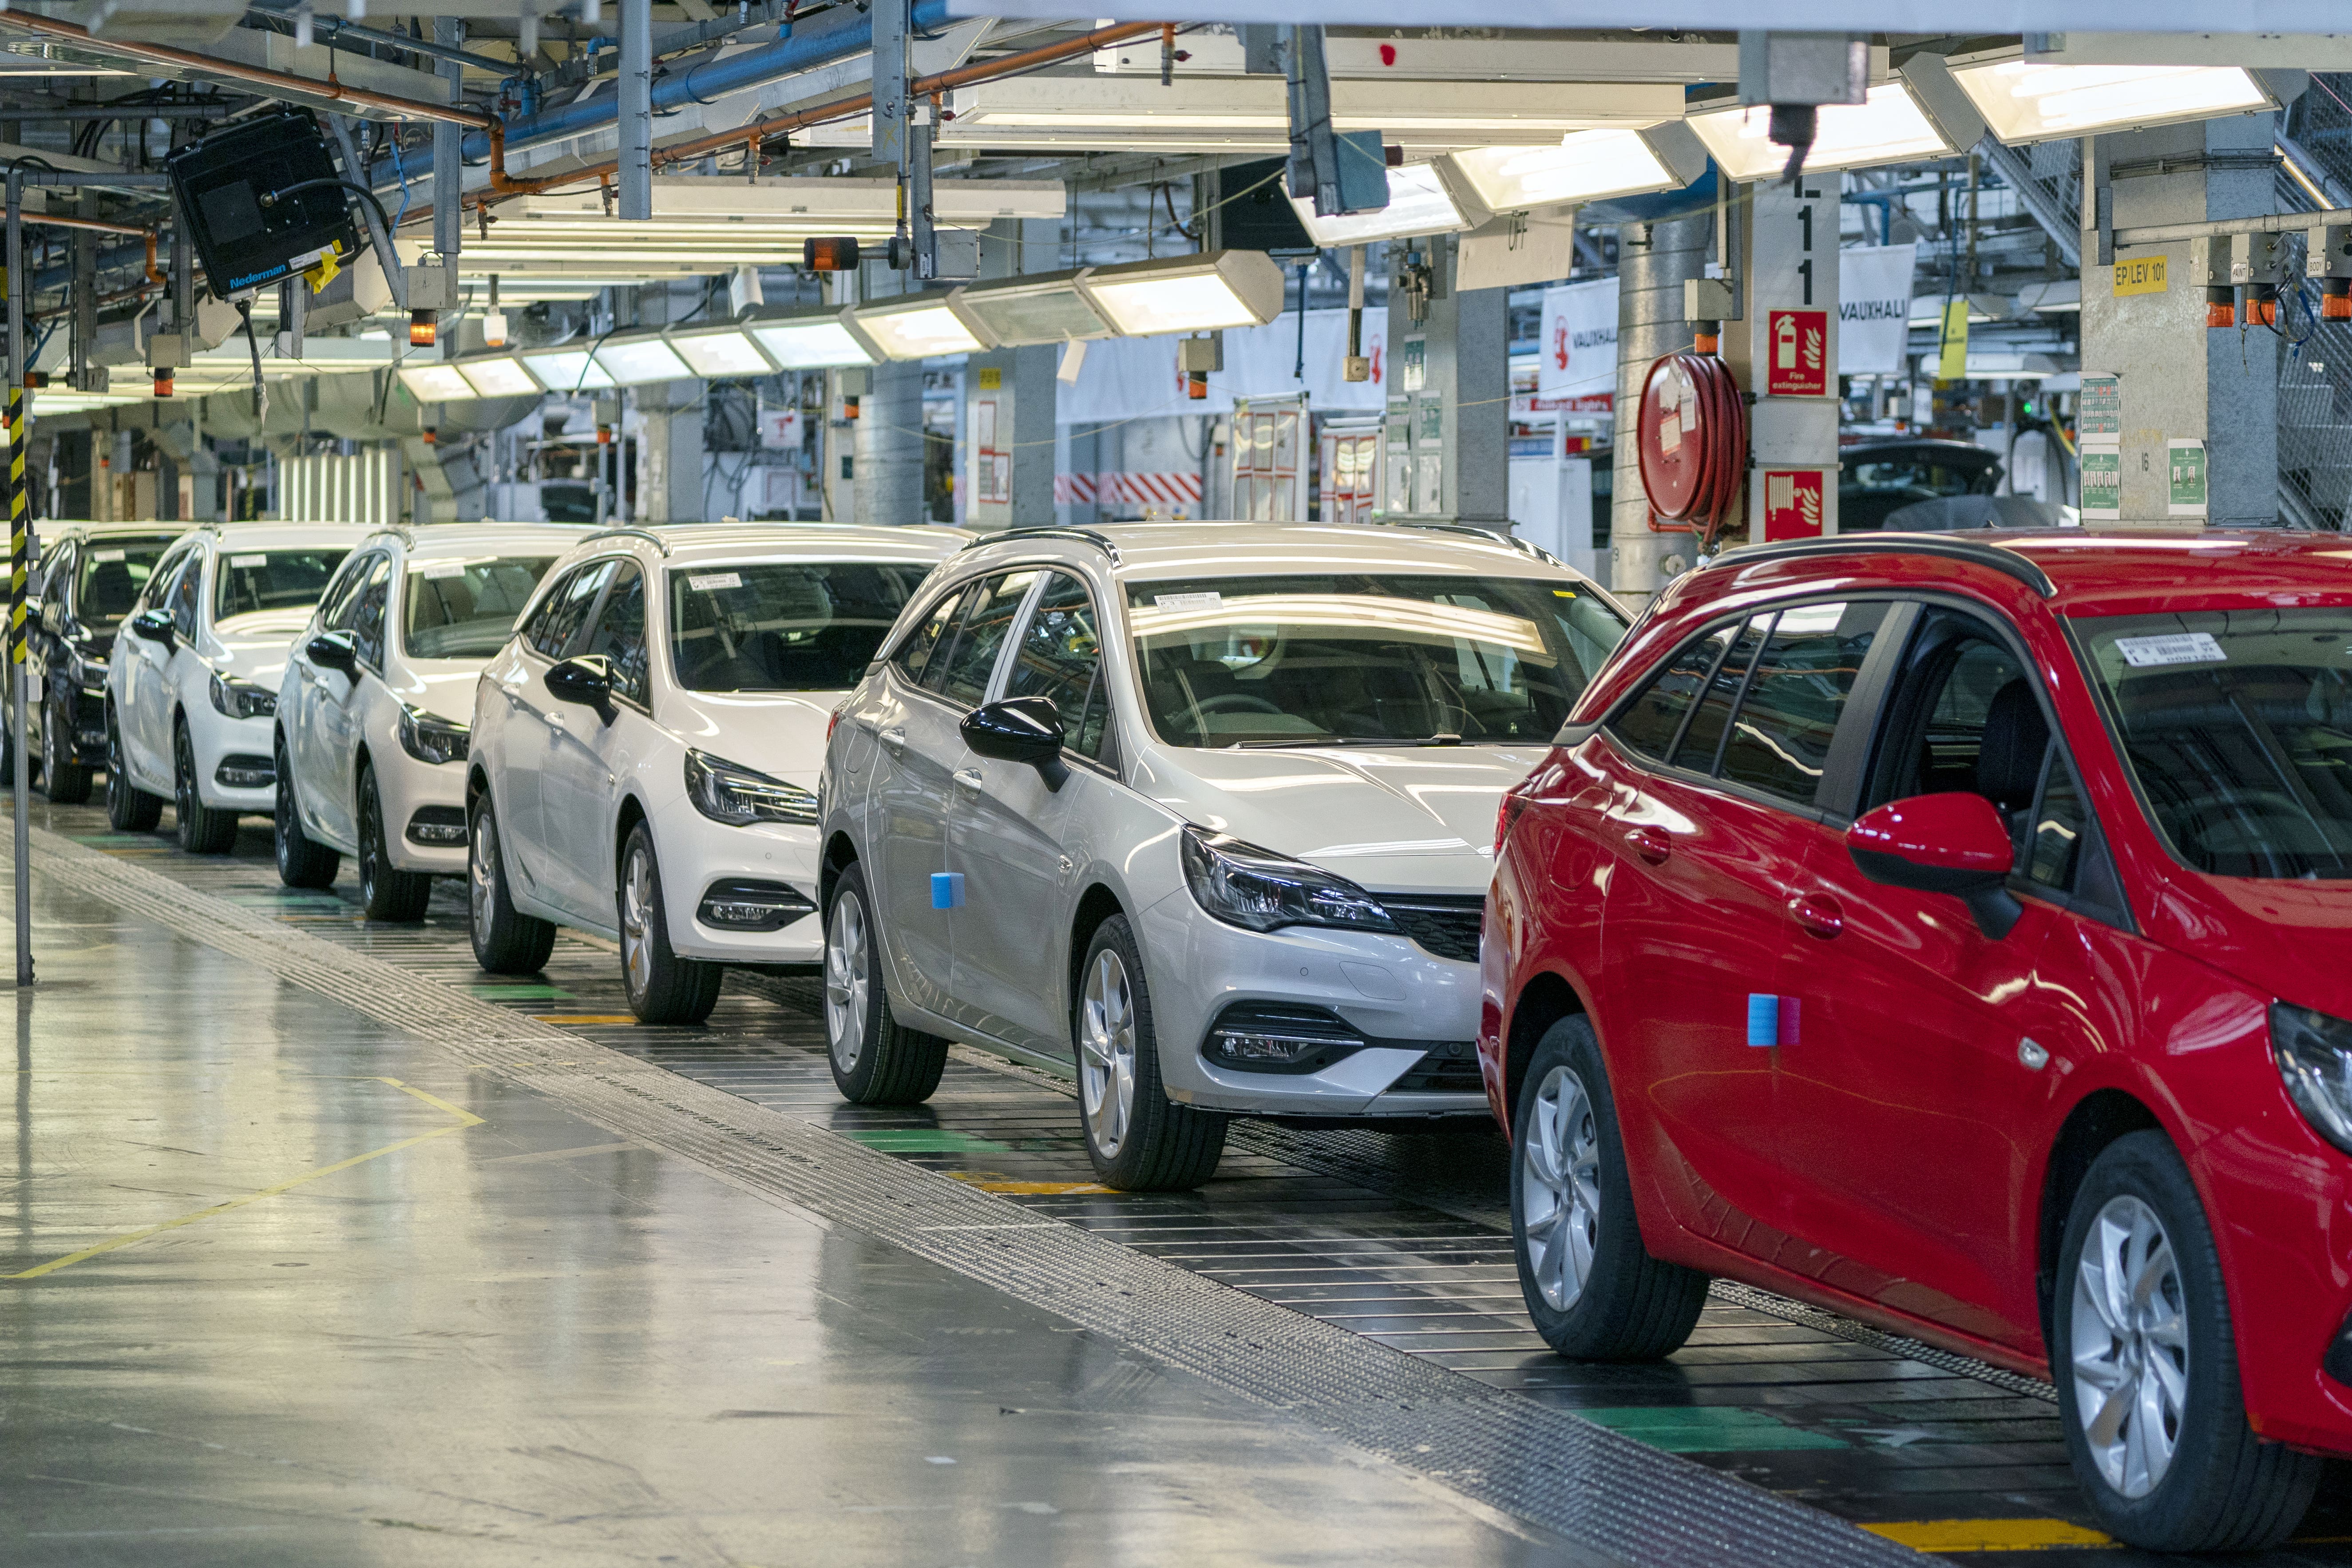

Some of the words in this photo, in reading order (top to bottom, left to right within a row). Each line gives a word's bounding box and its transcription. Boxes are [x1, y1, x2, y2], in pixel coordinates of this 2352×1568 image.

[2233, 267, 2246, 277] PAINT
[2309, 261, 2323, 272] BODY
[229, 264, 286, 289] Nederman
[2116, 263, 2149, 286] EP/LEV
[2152, 261, 2165, 281] 101
[1789, 372, 1805, 380] Fire
[1772, 382, 1821, 391] extinguisher
[2142, 452, 2149, 472] 16
